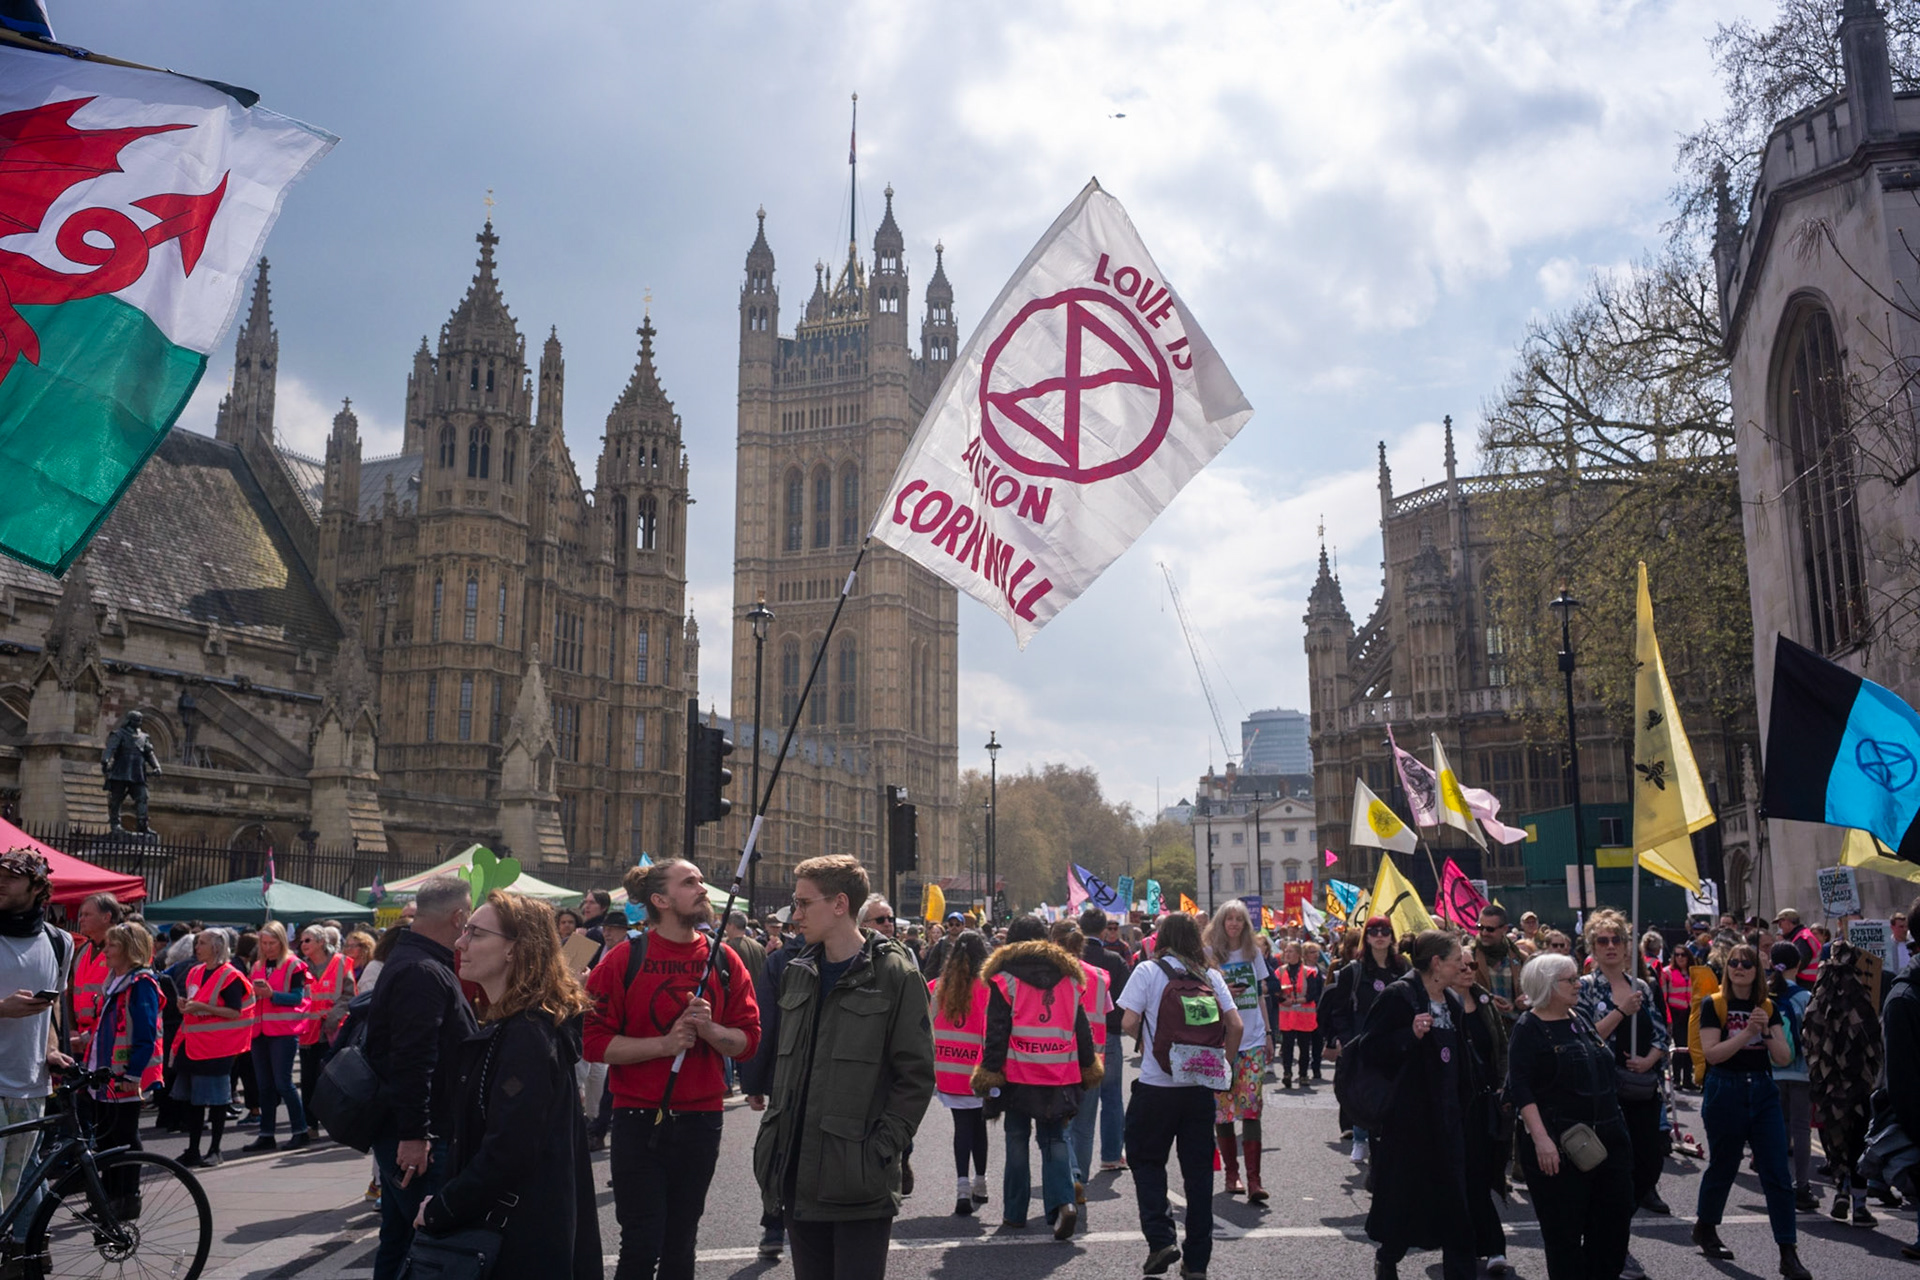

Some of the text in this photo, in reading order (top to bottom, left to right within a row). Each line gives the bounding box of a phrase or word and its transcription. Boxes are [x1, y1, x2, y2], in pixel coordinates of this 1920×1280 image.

[1093, 253, 1193, 371] LOVE IS
[1850, 935, 1885, 943] CHANGE
[935, 1045, 978, 1060] TEWAR
